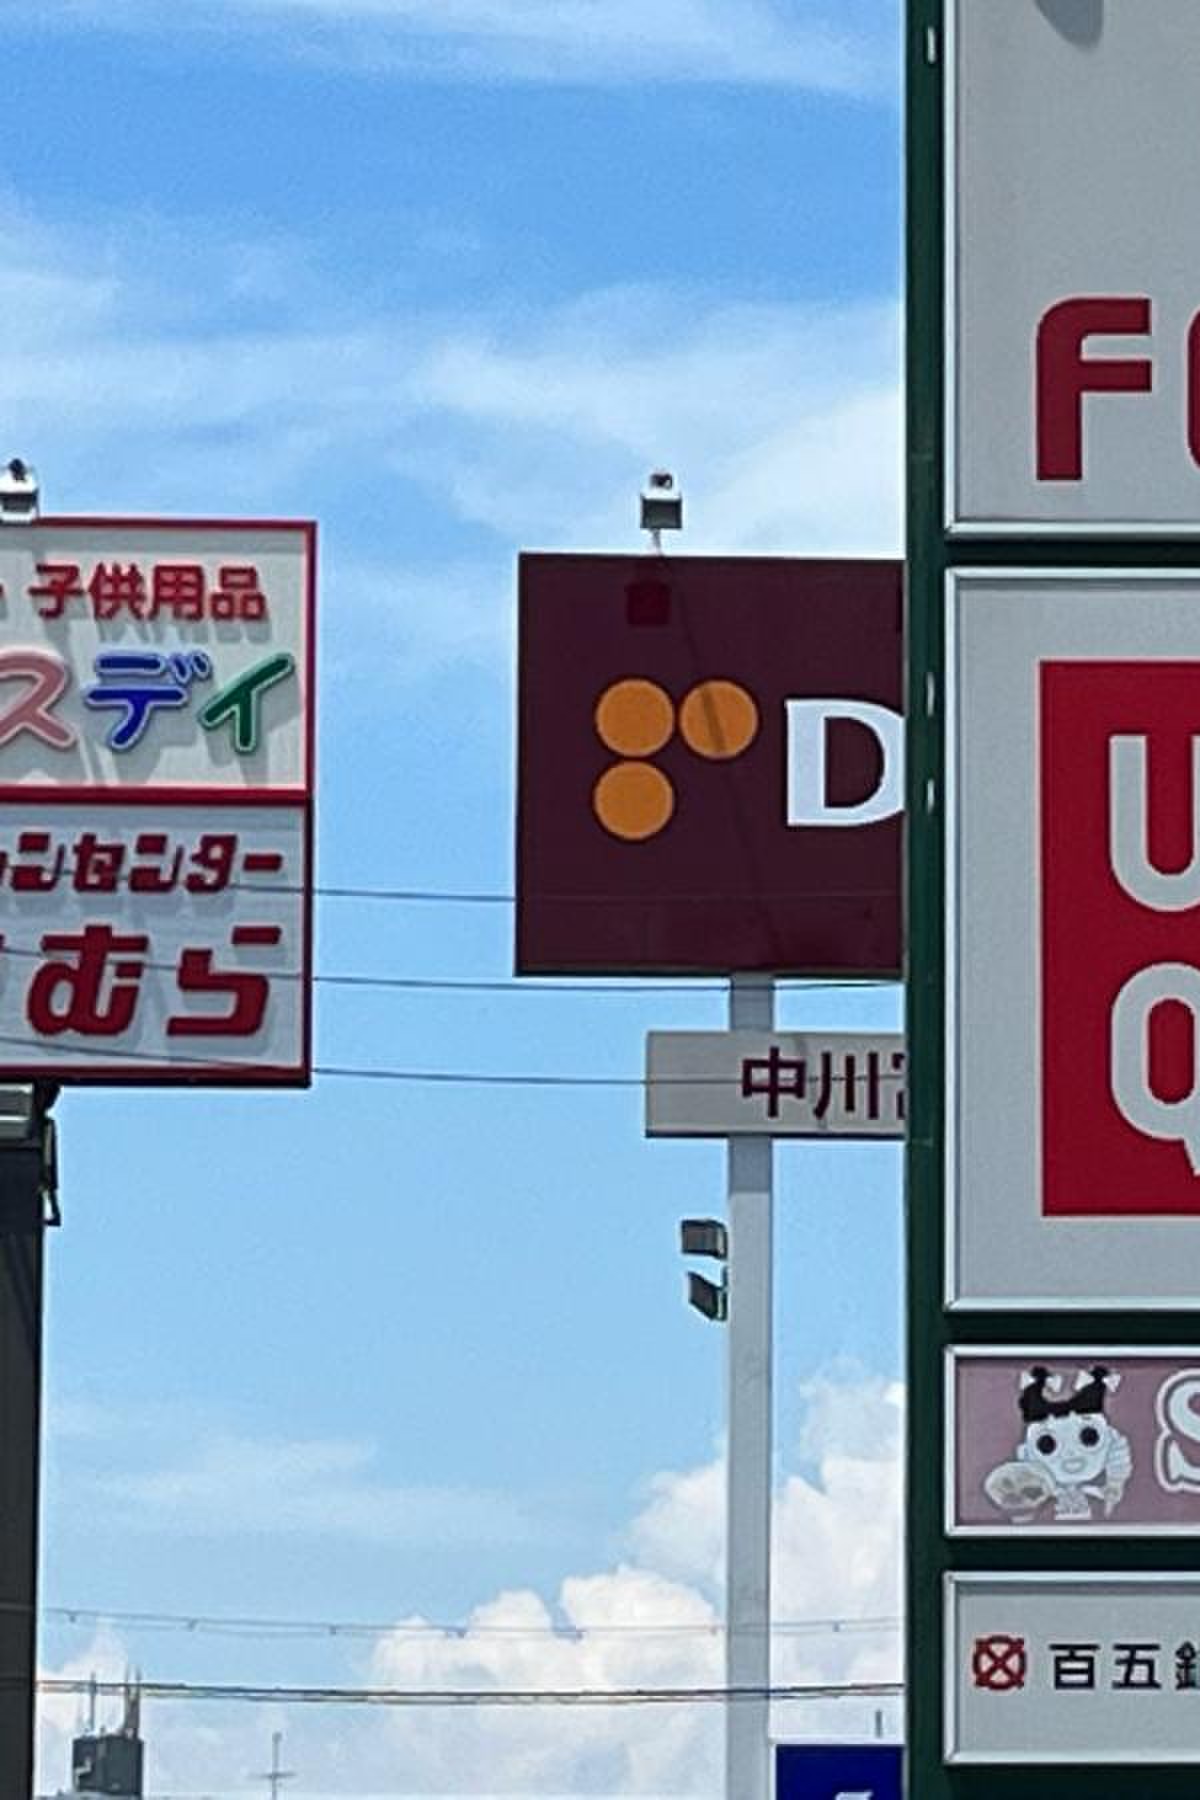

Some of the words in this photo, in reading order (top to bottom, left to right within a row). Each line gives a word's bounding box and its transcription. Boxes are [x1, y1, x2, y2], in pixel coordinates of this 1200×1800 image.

[0, 832, 283, 893] ンセンター
[0, 925, 282, 1036] むら
[740, 1046, 905, 1121] 中川
